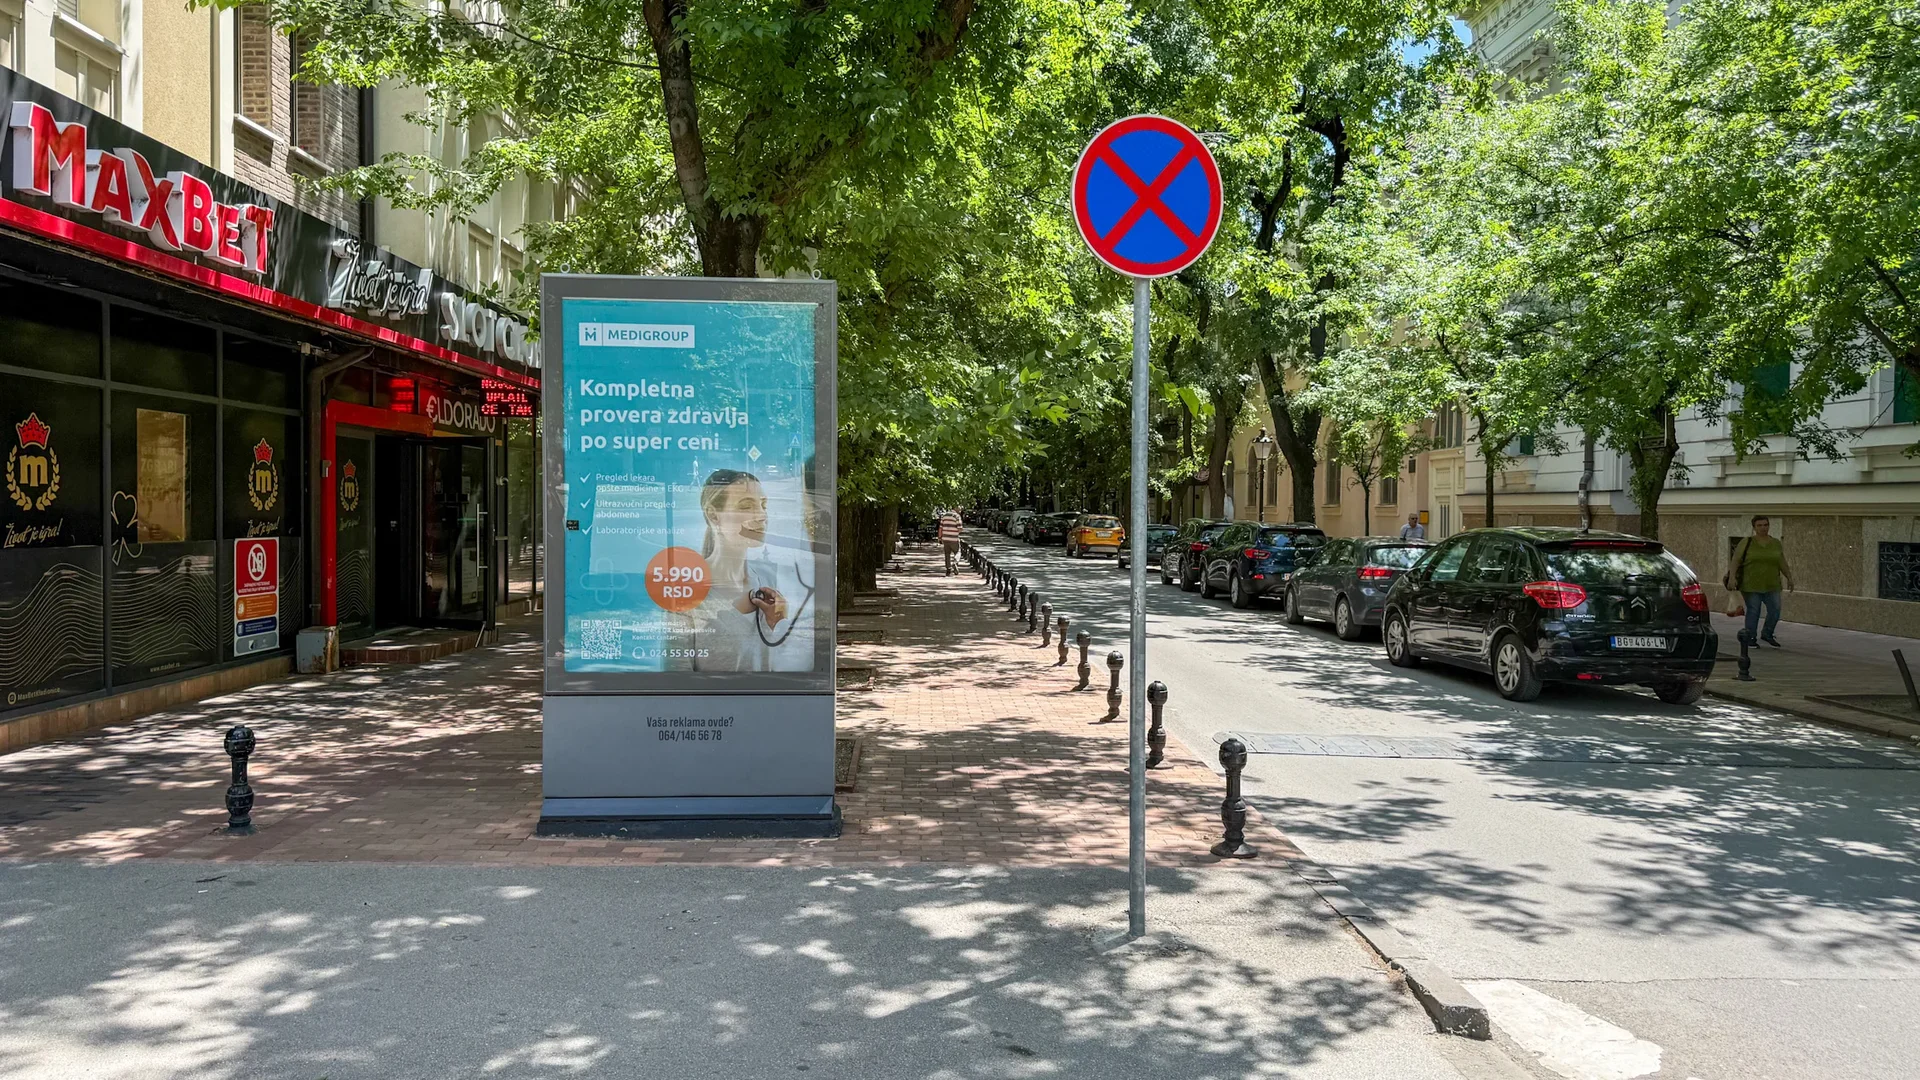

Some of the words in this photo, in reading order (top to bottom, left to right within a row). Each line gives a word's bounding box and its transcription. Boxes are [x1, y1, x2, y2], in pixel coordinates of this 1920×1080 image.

[10, 101, 274, 274] MAXBET
[397, 268, 434, 319] igra!
[608, 330, 689, 342] MEDIGROUP
[580, 379, 695, 400] Kompletna
[581, 408, 661, 426] provera
[668, 406, 749, 428] zdravlja
[581, 435, 607, 452] po
[613, 435, 672, 453] super
[677, 433, 719, 450] ceni
[595, 473, 629, 482] Pregled
[630, 473, 656, 481] lekara
[595, 484, 619, 492] opšte
[620, 483, 659, 492] medicine
[667, 484, 684, 493] EKG
[595, 499, 643, 508] Ultrazvučni
[645, 500, 676, 509] pregled
[595, 510, 640, 518] abdomena
[3, 522, 32, 549] Život
[27, 526, 39, 545] je
[38, 517, 63, 543] igra!
[596, 526, 655, 535] Laboratorijske
[656, 526, 685, 534] analize
[652, 566, 704, 583] 5.990
[662, 586, 693, 598] RSD
[1617, 637, 1629, 647] BG
[649, 649, 668, 658] 024
[669, 649, 682, 658] 55
[683, 649, 696, 658] 50
[697, 649, 709, 658] 25
[646, 716, 668, 728] Vaša
[669, 716, 706, 728] reklama
[707, 716, 734, 728] ovde?
[658, 730, 696, 742] 064/146
[698, 730, 709, 741] 56
[711, 730, 722, 741] 78
